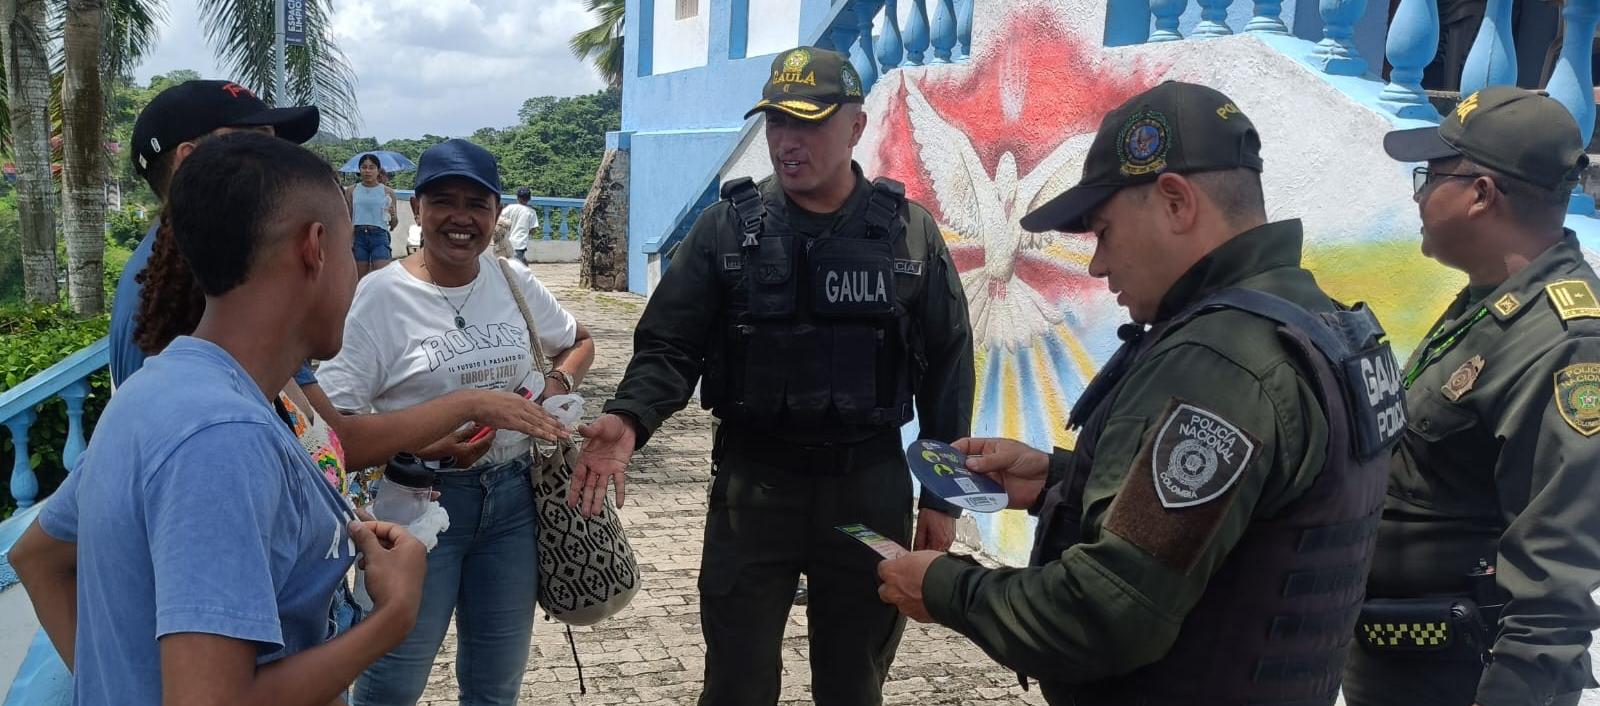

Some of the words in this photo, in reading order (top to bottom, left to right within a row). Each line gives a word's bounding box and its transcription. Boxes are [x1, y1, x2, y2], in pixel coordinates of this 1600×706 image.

[288, 0, 296, 31] ESPAC
[773, 70, 816, 86] GAULA
[825, 270, 887, 302] GAULA
[421, 323, 525, 373] ROME
[461, 367, 495, 385] EUROPE
[496, 364, 518, 379] ITALY
[1179, 423, 1234, 464] NACIONAL
[1190, 415, 1236, 448] POLICÍA
[1160, 472, 1198, 498] COLOMBIA
